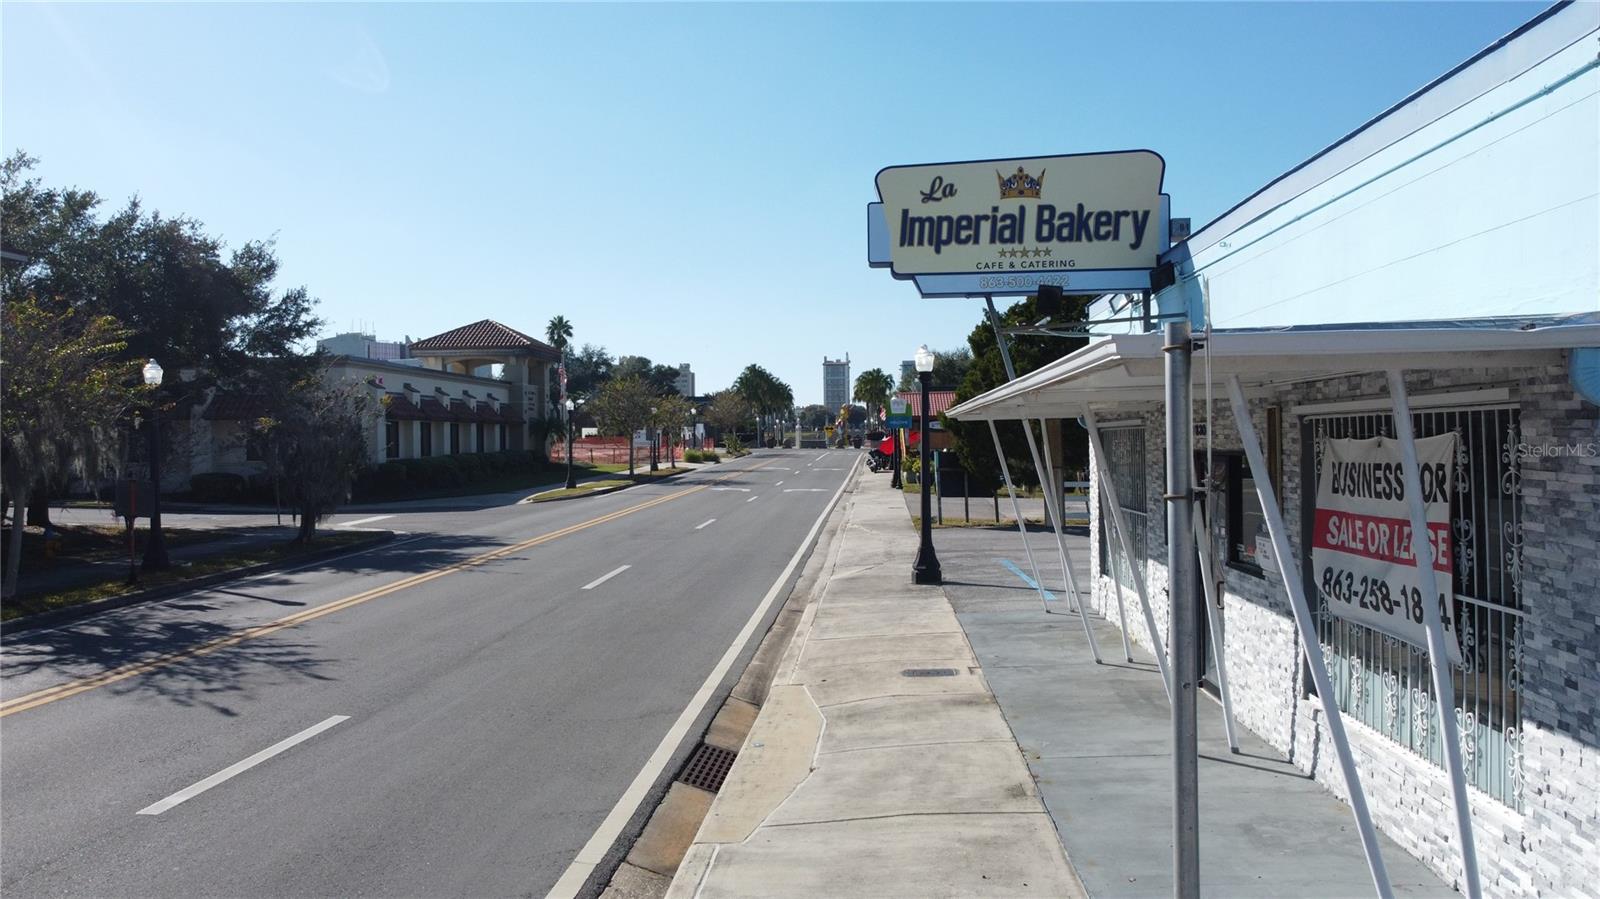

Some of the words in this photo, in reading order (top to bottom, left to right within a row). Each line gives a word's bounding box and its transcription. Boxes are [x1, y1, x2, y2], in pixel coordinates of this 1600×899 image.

[920, 176, 957, 203] La
[900, 205, 1025, 254] Imperial
[1036, 203, 1150, 250] Bakery
[976, 262, 1004, 270] CAFE
[1021, 260, 1075, 269] CATERING
[1332, 462, 1404, 501] BUSINESS
[1417, 462, 1448, 503] OR
[1327, 516, 1364, 550] SALE
[1367, 521, 1389, 555] OR
[1322, 566, 1451, 632] 863-258-184
